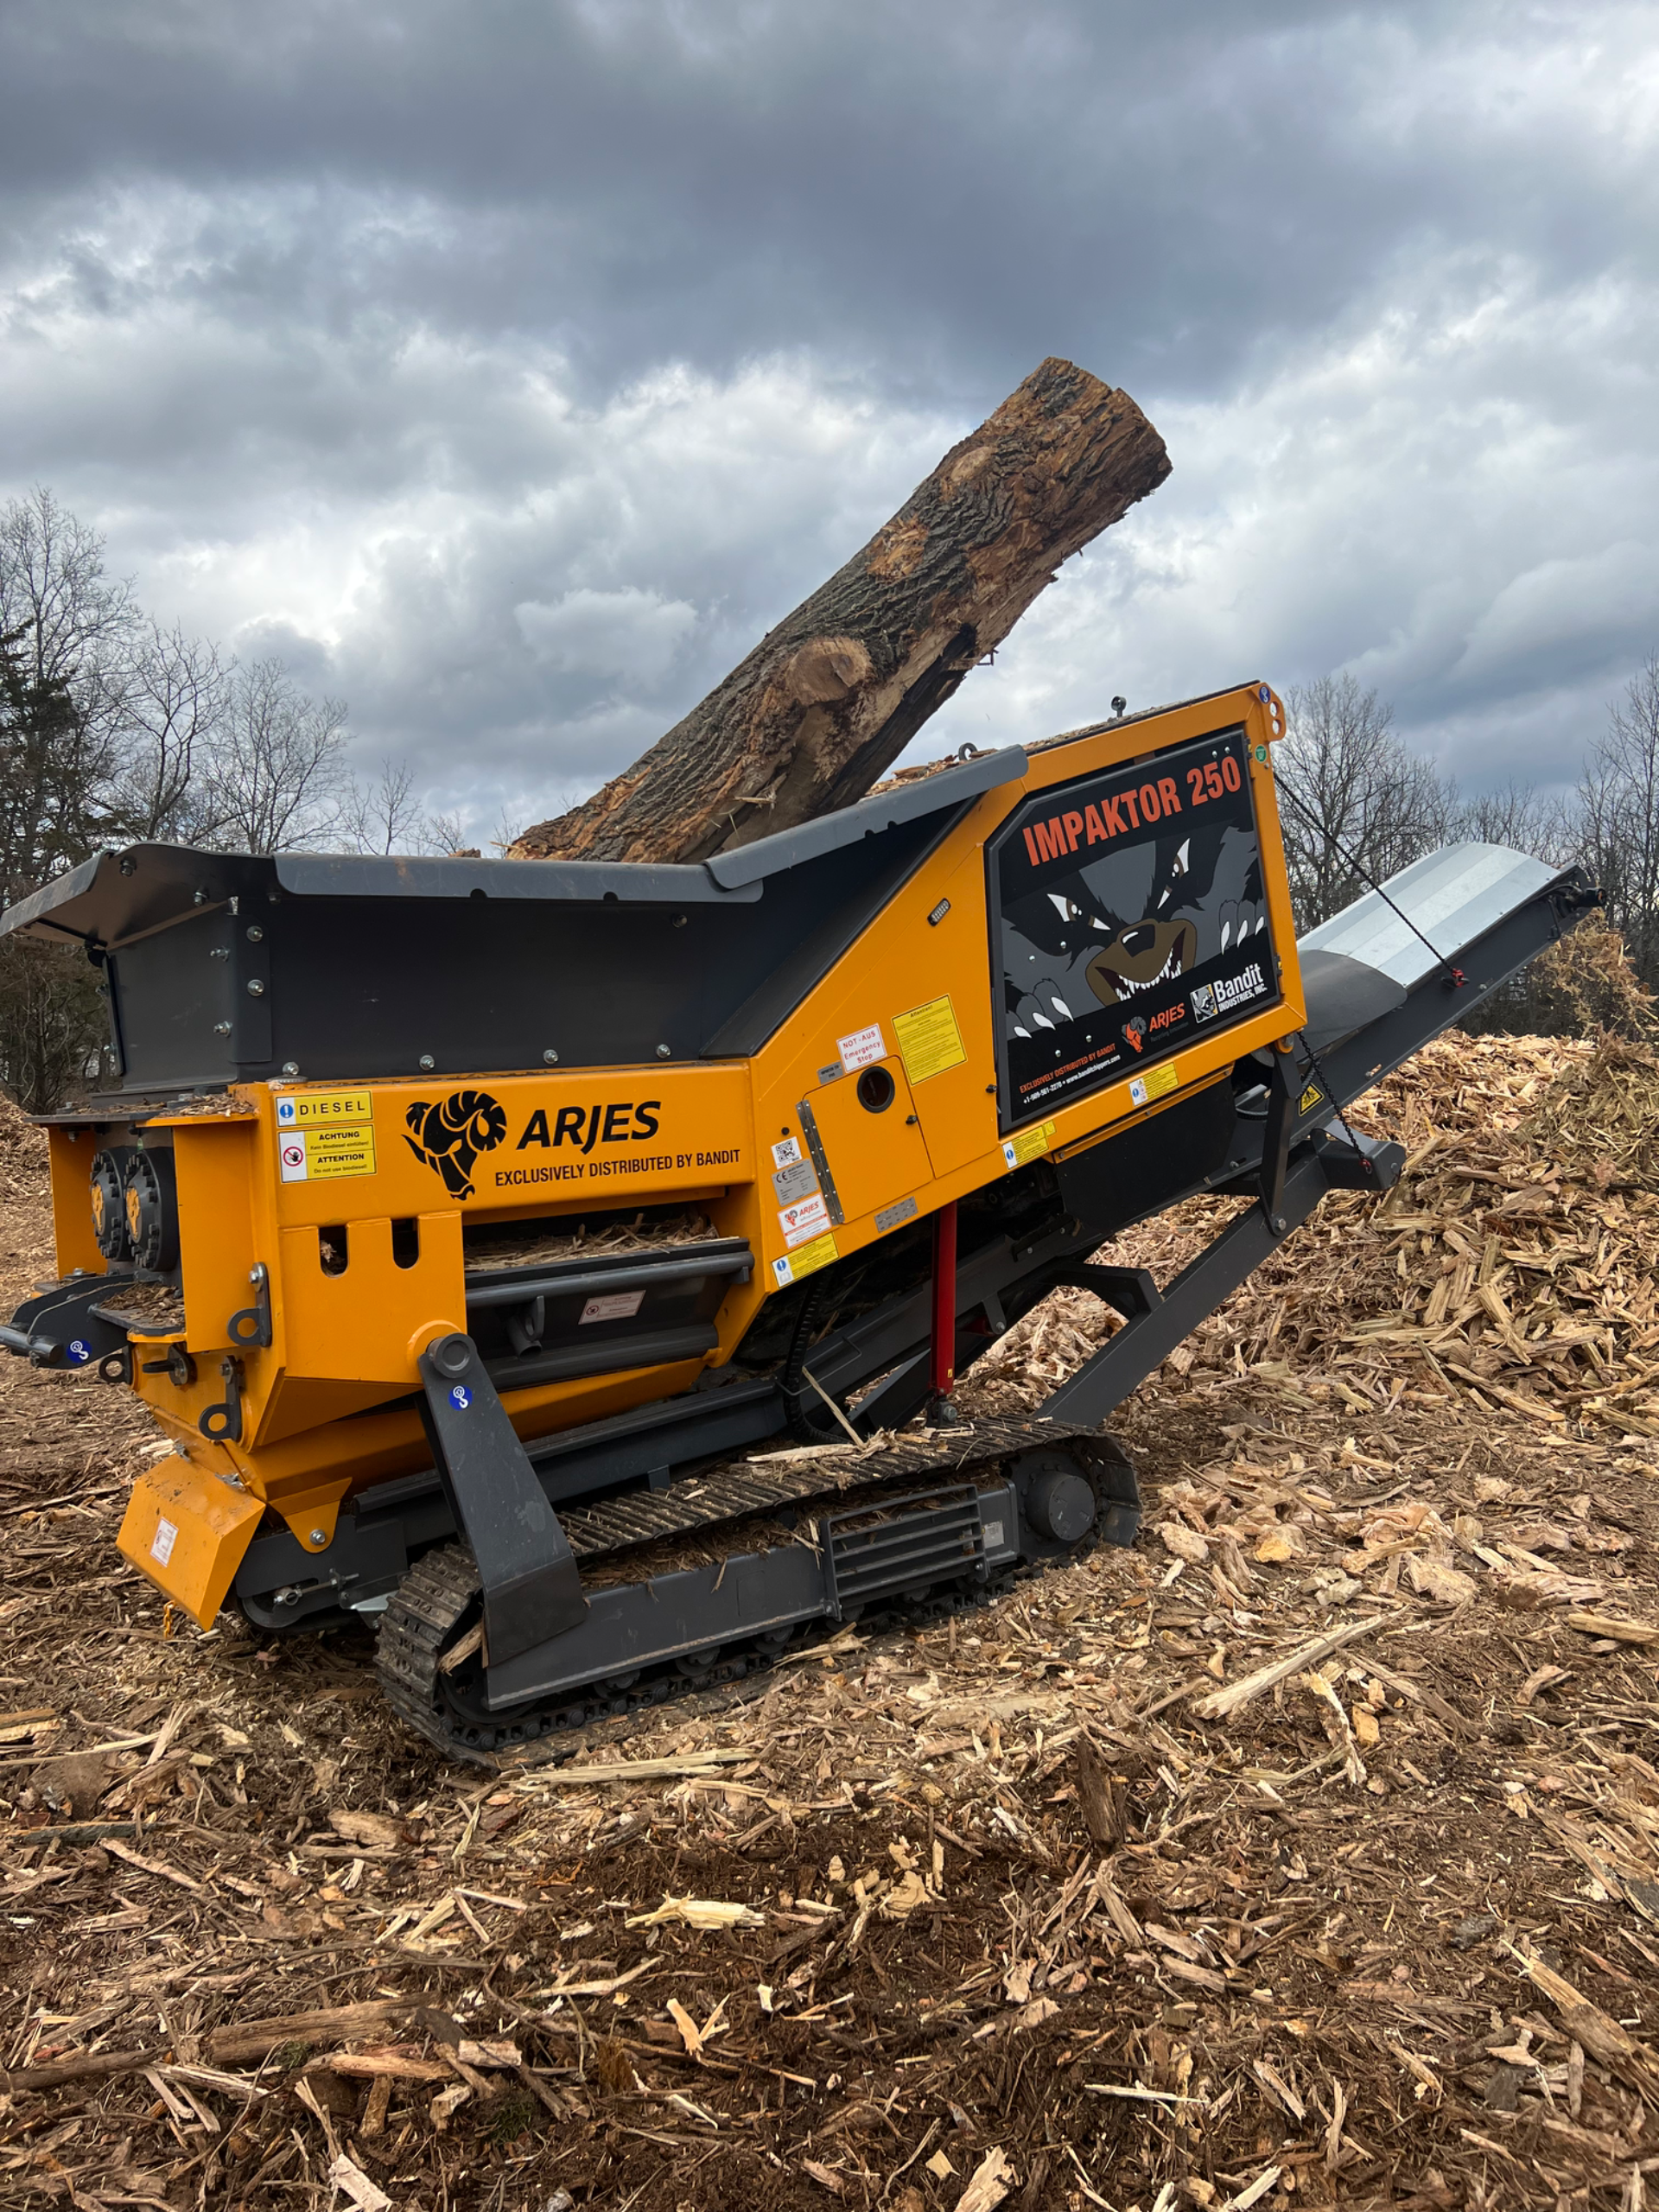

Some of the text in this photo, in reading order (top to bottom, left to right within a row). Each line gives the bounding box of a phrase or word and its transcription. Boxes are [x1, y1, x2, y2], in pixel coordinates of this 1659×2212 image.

[1022, 756, 1241, 867] IMPAKTOR 250
[1213, 963, 1264, 1002] Bandit
[1255, 982, 1268, 996] INC.
[1149, 1002, 1185, 1033] ARJES
[844, 1041, 880, 1060] Emergency
[857, 1053, 873, 1064] Stop
[1020, 1042, 1116, 1094] EXCLUSIVELY DISTRIBUTED BY BANDIT
[300, 1100, 365, 1116] DIESEL
[319, 1131, 360, 1141] ACHTUNG
[515, 1100, 662, 1155] ARJES
[317, 1154, 365, 1163] ATTENTION
[495, 1149, 741, 1186] EXCLUSIVELY DISTRIBUTED BY BANDIT
[799, 1201, 819, 1217] ARJES
